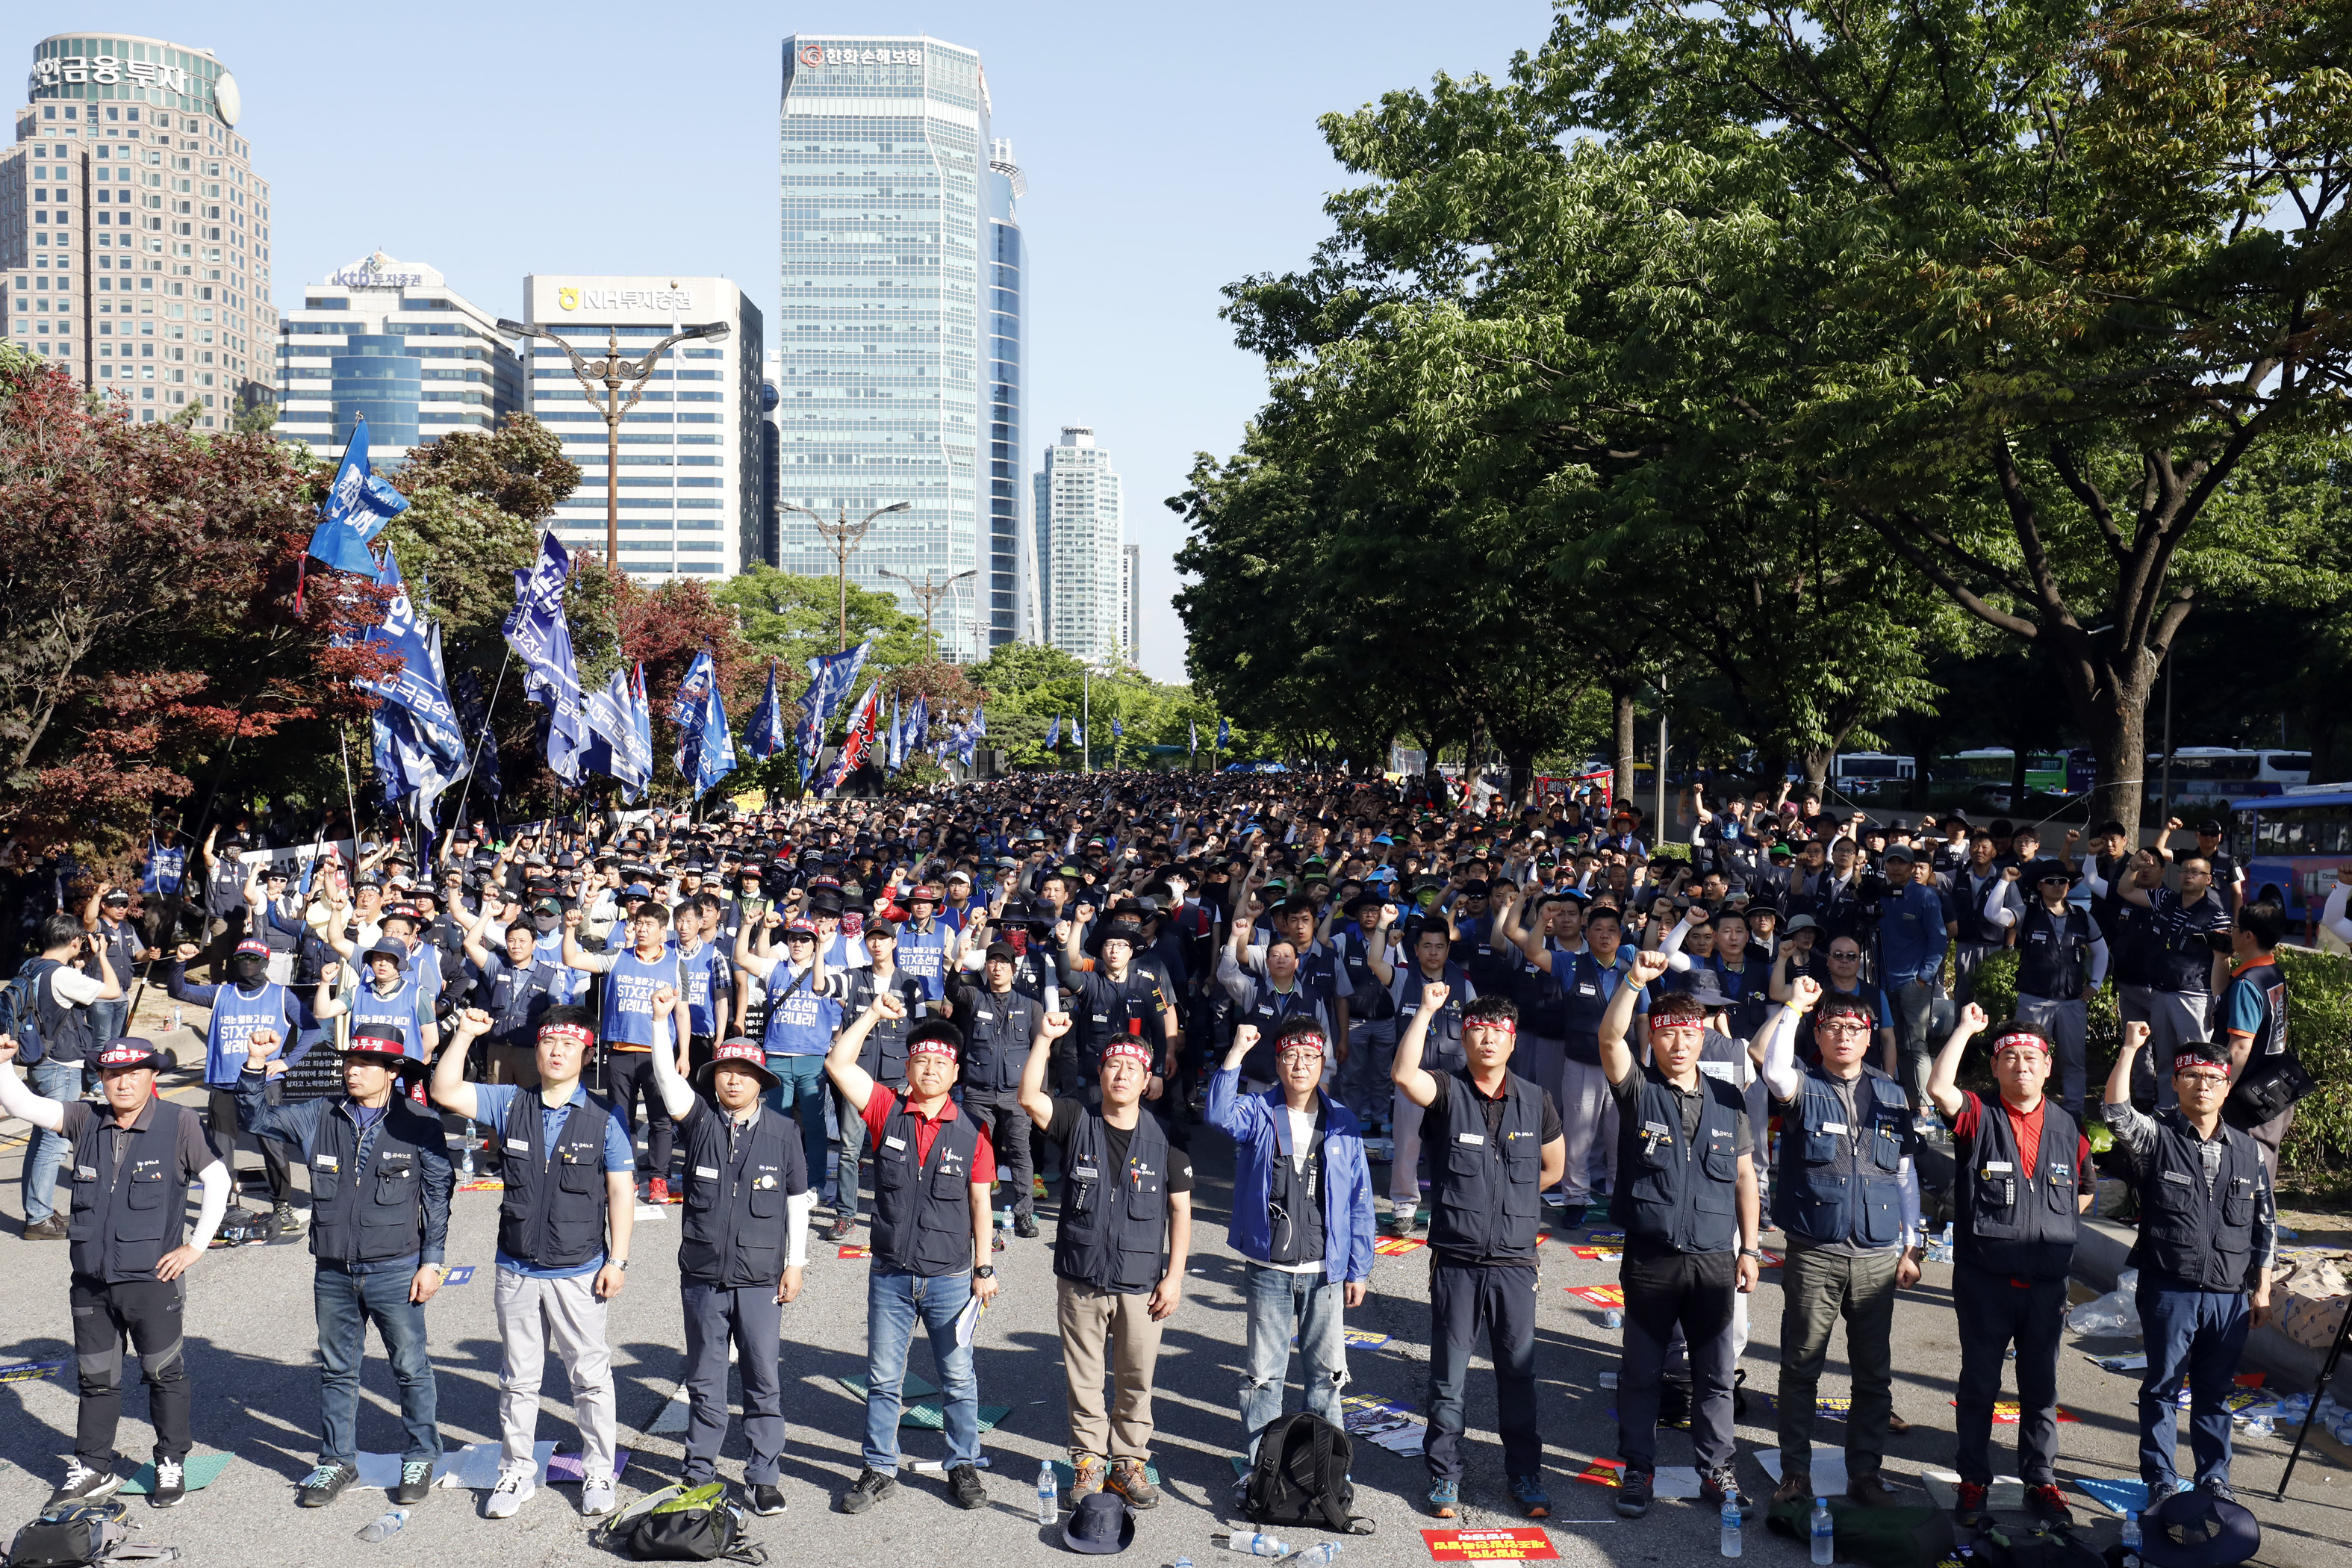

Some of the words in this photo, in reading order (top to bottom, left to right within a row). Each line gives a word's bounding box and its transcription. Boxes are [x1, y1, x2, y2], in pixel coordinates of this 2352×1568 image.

[827, 49, 921, 66] 한화손해보험
[583, 290, 693, 311] NH투자증권
[899, 955, 940, 966] STX조선을
[617, 974, 634, 984] 우리는
[634, 977, 655, 987] 일하고
[237, 1015, 260, 1024] 일하고
[355, 1015, 371, 1024] 우리는
[372, 1015, 393, 1024] 일하고
[567, 1024, 588, 1040] 투쟁
[359, 1038, 385, 1051] 투쟁
[1993, 1036, 2006, 1054] 단결
[2017, 1033, 2041, 1048] 투쟁
[716, 1047, 732, 1060] 단결
[744, 1047, 762, 1062] 투쟁
[909, 1042, 927, 1055] 단결
[939, 1042, 956, 1060] 투쟁
[1105, 1045, 1123, 1057] 단결
[1134, 1048, 1151, 1068] 투쟁
[100, 1052, 116, 1063] 단결
[2176, 1054, 2193, 1068] 단결
[312, 1060, 343, 1068] 죄송합니다
[305, 1080, 342, 1088] 노력했습니다
[1719, 1130, 1733, 1139] 금속노조
[1457, 1533, 1515, 1541] 입법쟁취
[1433, 1540, 1547, 1551] 제조업발전특별법
[1463, 1549, 1526, 1559] 재벌개혁,
